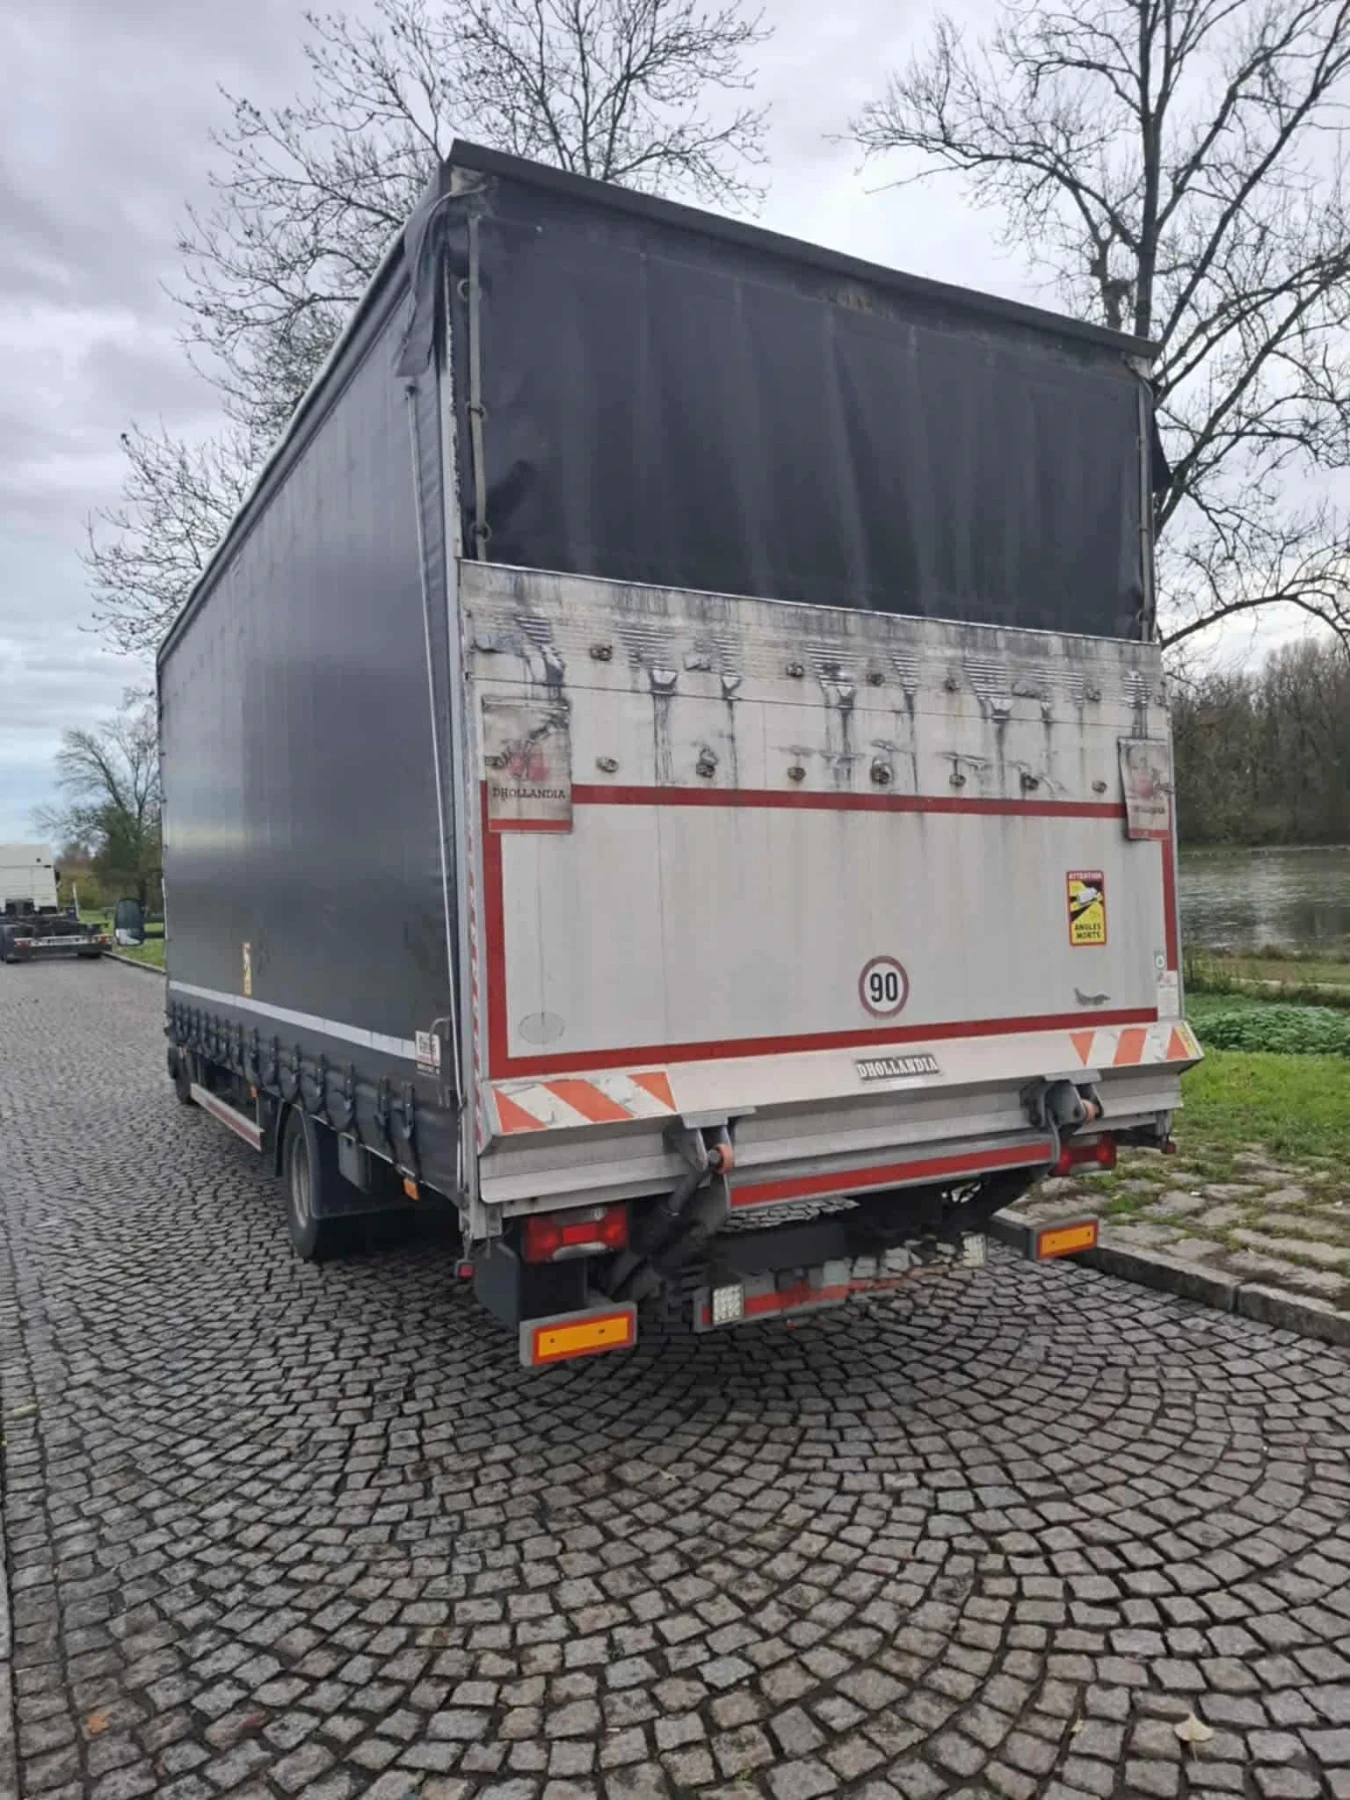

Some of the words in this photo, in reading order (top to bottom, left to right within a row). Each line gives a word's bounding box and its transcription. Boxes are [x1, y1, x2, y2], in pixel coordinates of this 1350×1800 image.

[492, 787, 566, 800] DHOLLANDIA
[1068, 872, 1102, 880] ATTENTION
[870, 972, 898, 1002] 90
[857, 1057, 938, 1077] DHOLLANDIA
